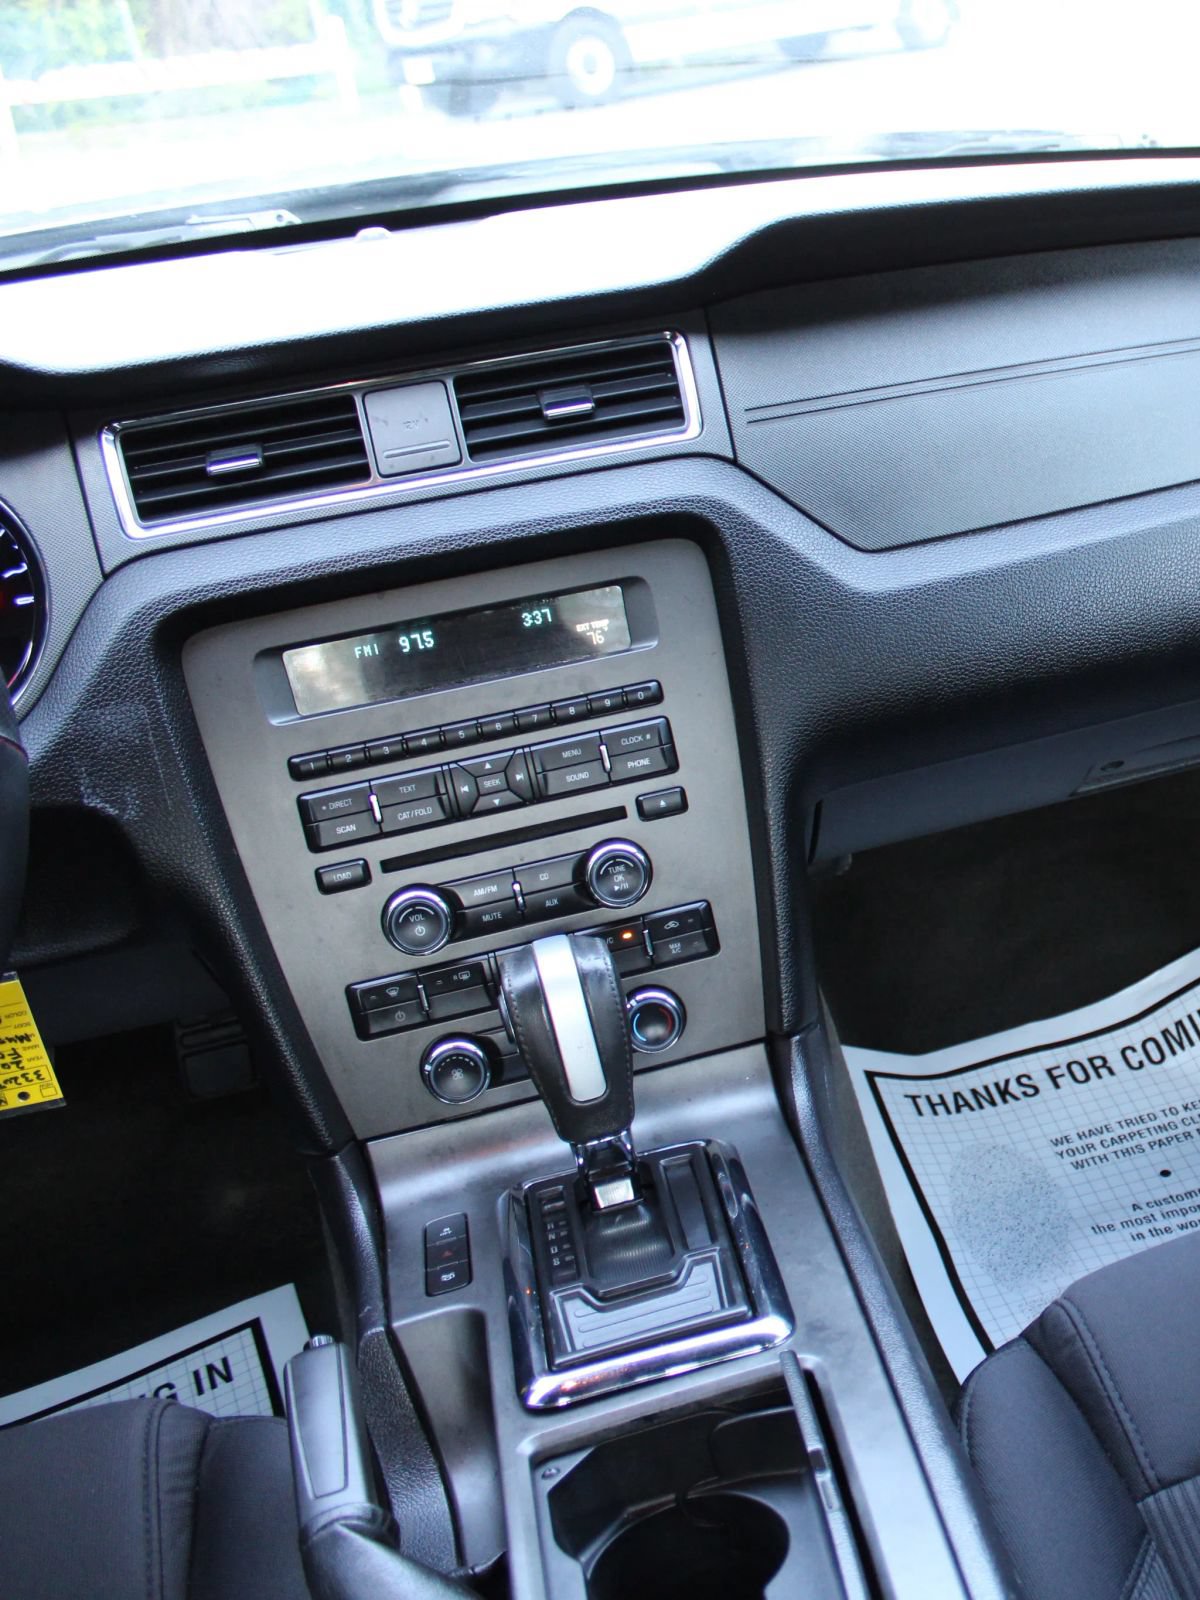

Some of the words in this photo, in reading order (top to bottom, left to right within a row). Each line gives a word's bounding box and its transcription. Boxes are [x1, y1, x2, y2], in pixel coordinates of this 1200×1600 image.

[586, 629, 605, 645] 76
[637, 691, 644, 700] 0
[604, 699, 611, 707] 9
[568, 706, 575, 715] 8
[532, 714, 538, 722] 7
[495, 722, 502, 731] 6
[458, 730, 465, 739] 5
[421, 738, 427, 746] 4
[621, 735, 643, 746] CLOCK
[383, 746, 390, 754] 3
[561, 748, 582, 759] MENU
[345, 755, 352, 763] 2
[627, 757, 651, 769] PHONE
[566, 771, 589, 783] SOUND
[483, 778, 501, 788] SEEK
[398, 784, 416, 794] TEXT
[328, 798, 353, 810] DIRECT
[336, 823, 356, 835] SCAN
[608, 864, 626, 874] TUNE
[333, 872, 352, 882] LOAD
[539, 872, 549, 881] CD
[613, 873, 625, 883] OK
[473, 885, 498, 897] AM/FM
[545, 898, 559, 908] AUX
[409, 913, 425, 923] VOL
[482, 912, 502, 922] MUTE
[904, 1074, 1040, 1118] THANKS
[1046, 1055, 1116, 1091] FOR
[1050, 1135, 1073, 1148] WE
[1076, 1123, 1114, 1141] HAVE
[1117, 1112, 1157, 1130] TRIED
[1160, 1106, 1179, 1118] TO
[1055, 1142, 1097, 1160] YOUR
[1100, 1120, 1178, 1149] CARPETING
[1070, 1154, 1109, 1171] WITH
[1112, 1144, 1146, 1160] THIS
[1149, 1131, 1194, 1151] PAPER
[1131, 1202, 1143, 1212] A
[1091, 1222, 1117, 1235] the
[1120, 1212, 1157, 1230] most
[1131, 1231, 1146, 1242] in
[1148, 1221, 1174, 1238] the
[193, 1356, 233, 1396] IN
